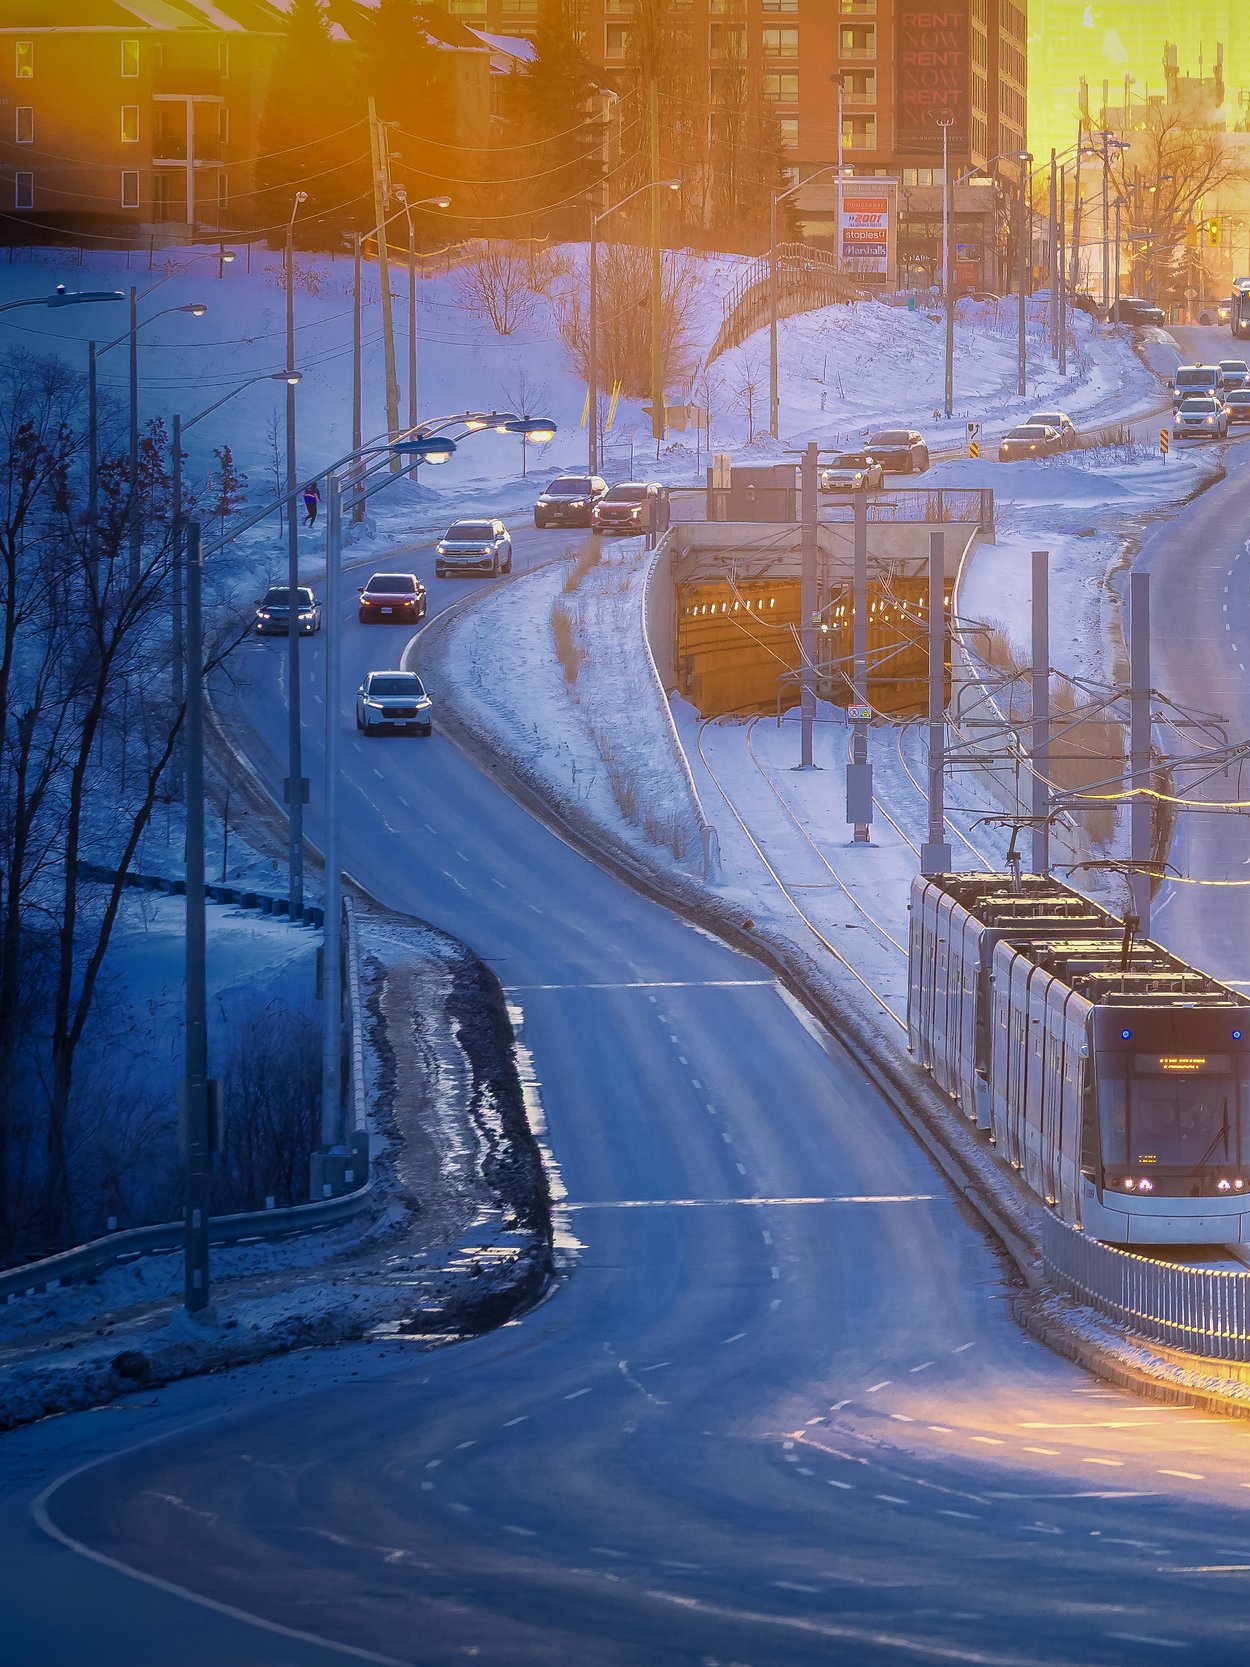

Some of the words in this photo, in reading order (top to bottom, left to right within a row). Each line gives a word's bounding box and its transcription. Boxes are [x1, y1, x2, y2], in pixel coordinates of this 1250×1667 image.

[903, 13, 964, 27] RENT
[905, 31, 962, 49] NOW
[903, 52, 964, 66] RENT
[905, 69, 962, 88] NOW
[903, 90, 963, 104] RENT
[845, 231, 879, 239] staples
[845, 245, 886, 255] Marshalls
